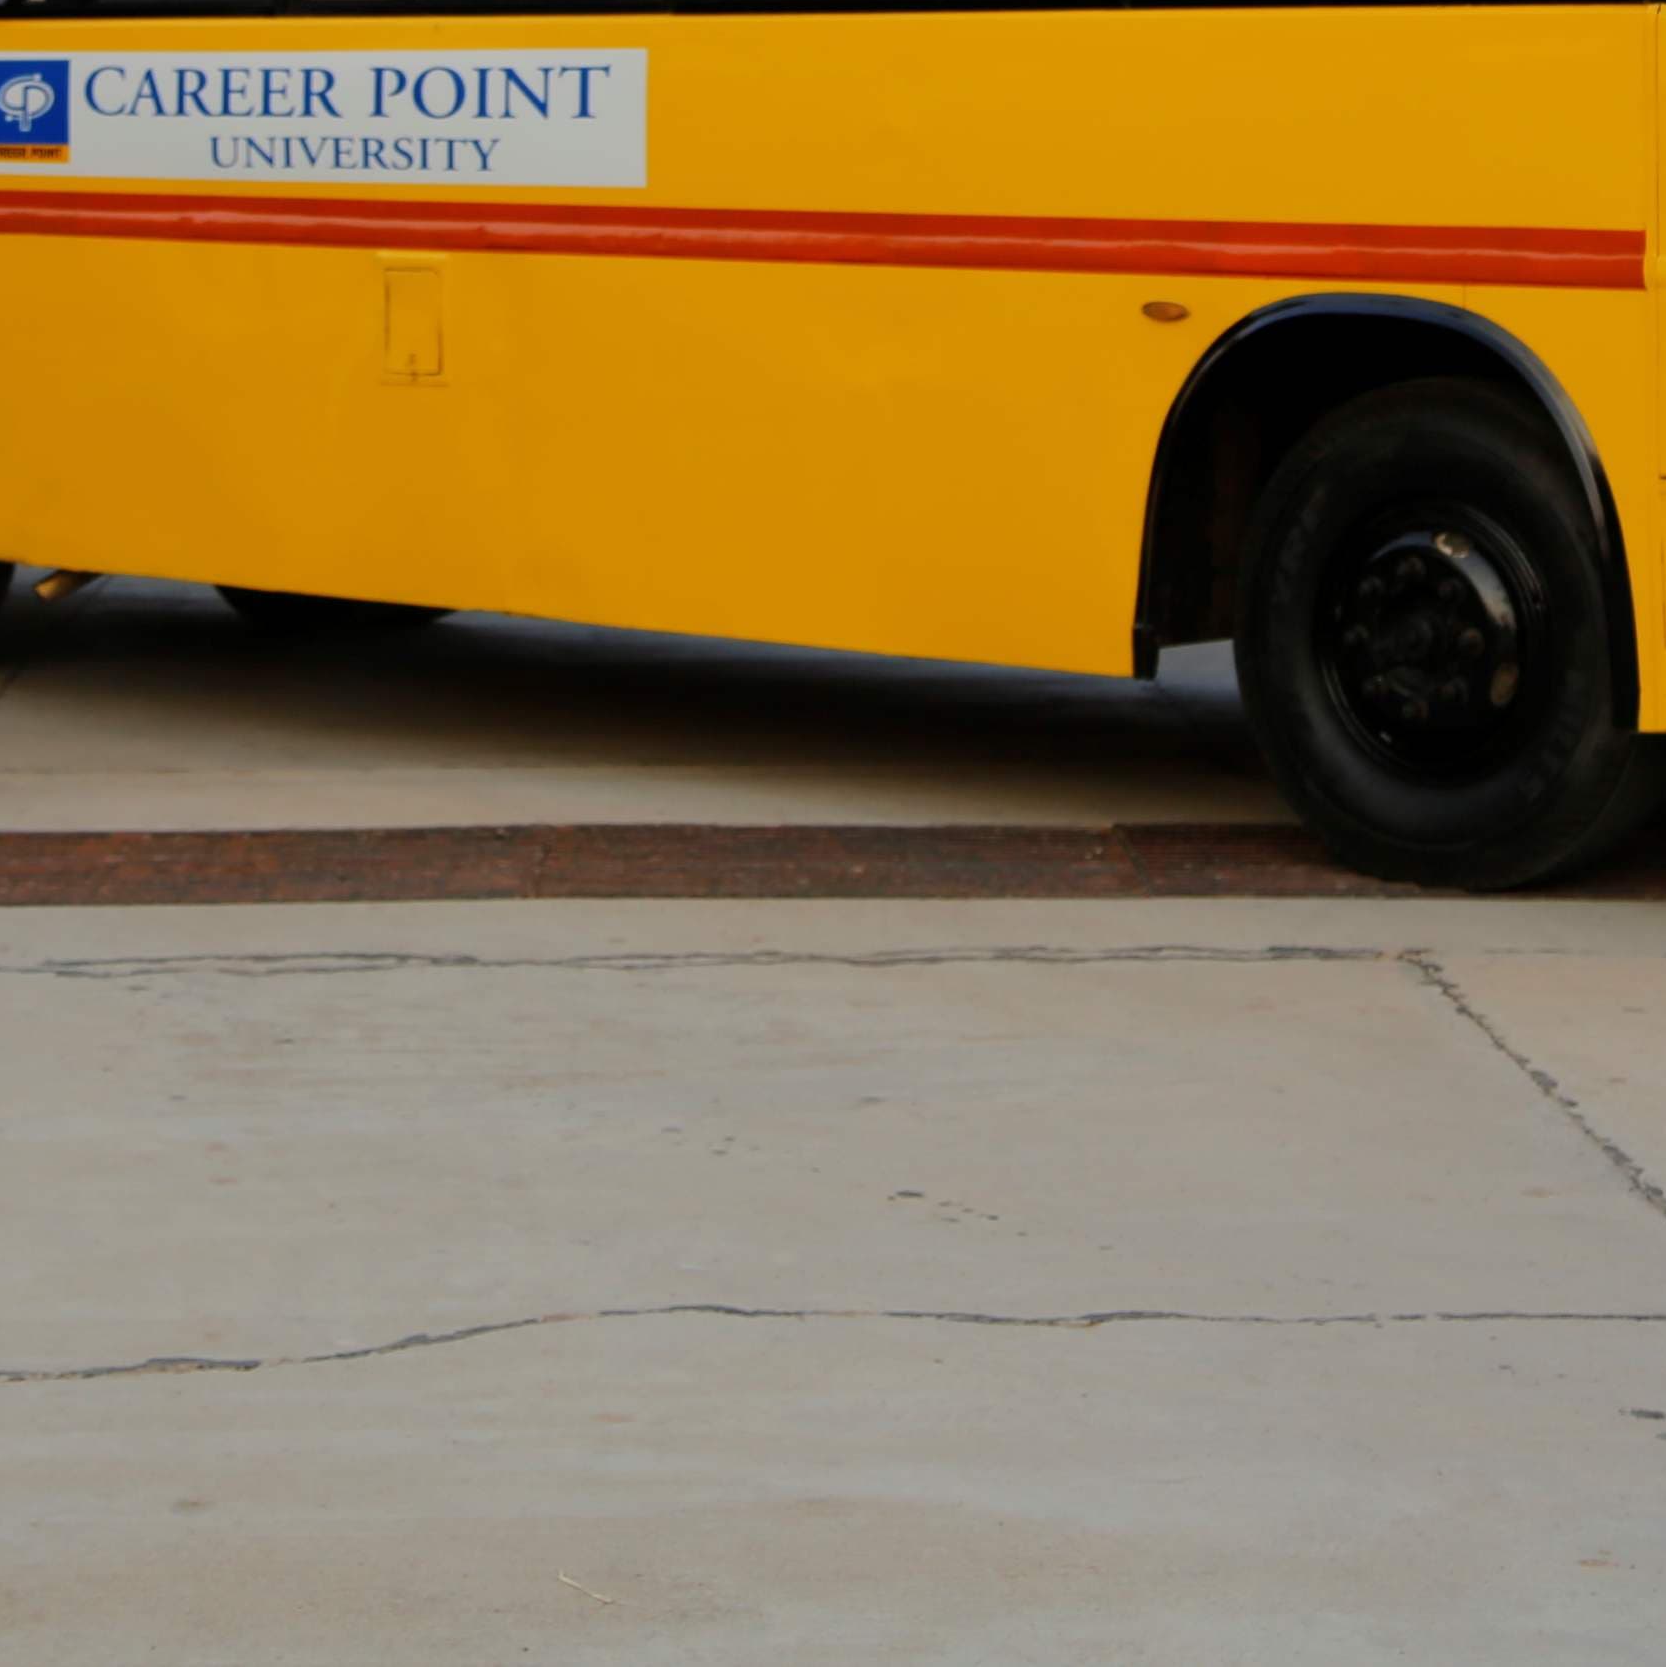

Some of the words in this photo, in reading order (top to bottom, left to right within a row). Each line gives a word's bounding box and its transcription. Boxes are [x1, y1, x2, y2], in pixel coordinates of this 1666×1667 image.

[84, 66, 339, 119] CAREER
[369, 65, 611, 119] POINT
[209, 135, 500, 171] UNIVERSITY
